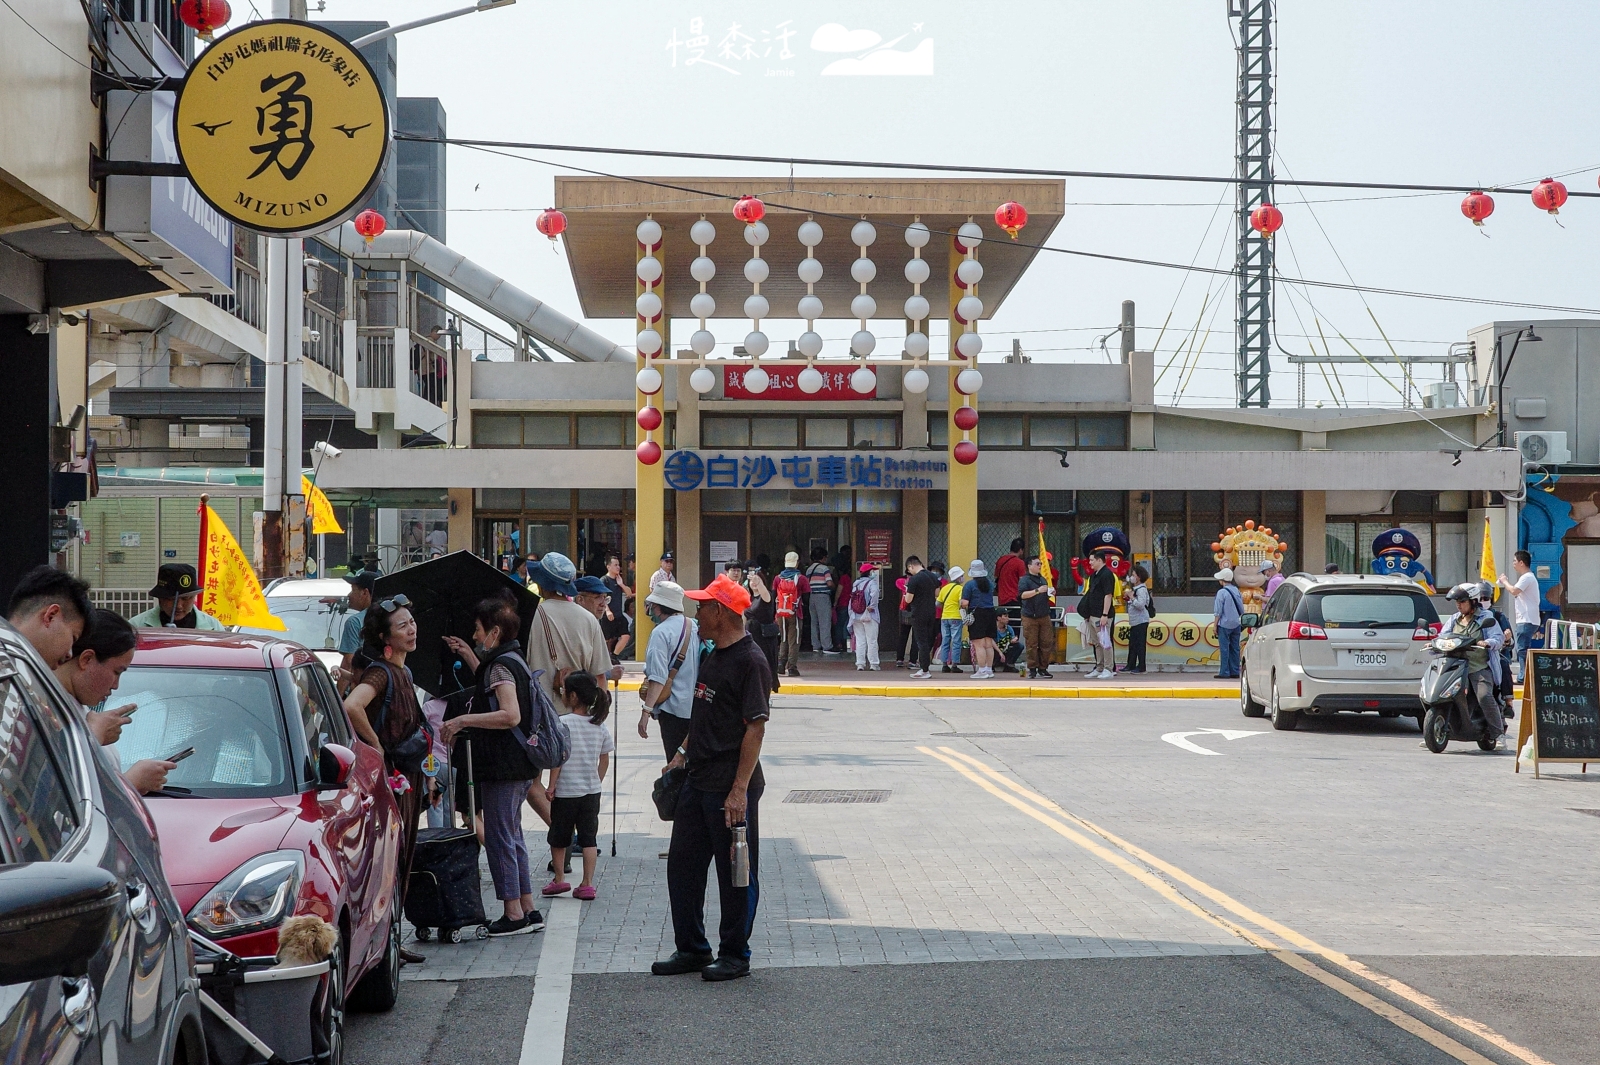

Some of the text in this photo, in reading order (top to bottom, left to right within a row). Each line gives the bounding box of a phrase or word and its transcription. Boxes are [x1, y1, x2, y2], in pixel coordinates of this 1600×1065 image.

[206, 36, 361, 88] 白沙屯媽祖聯名形象店
[246, 71, 315, 181] 勇
[234, 191, 328, 217] MIZUNO
[707, 454, 882, 488] 白沙屯車站
[884, 456, 948, 472] Baishatun
[884, 474, 933, 489] Station
[1118, 627, 1219, 642] 敬媽祖
